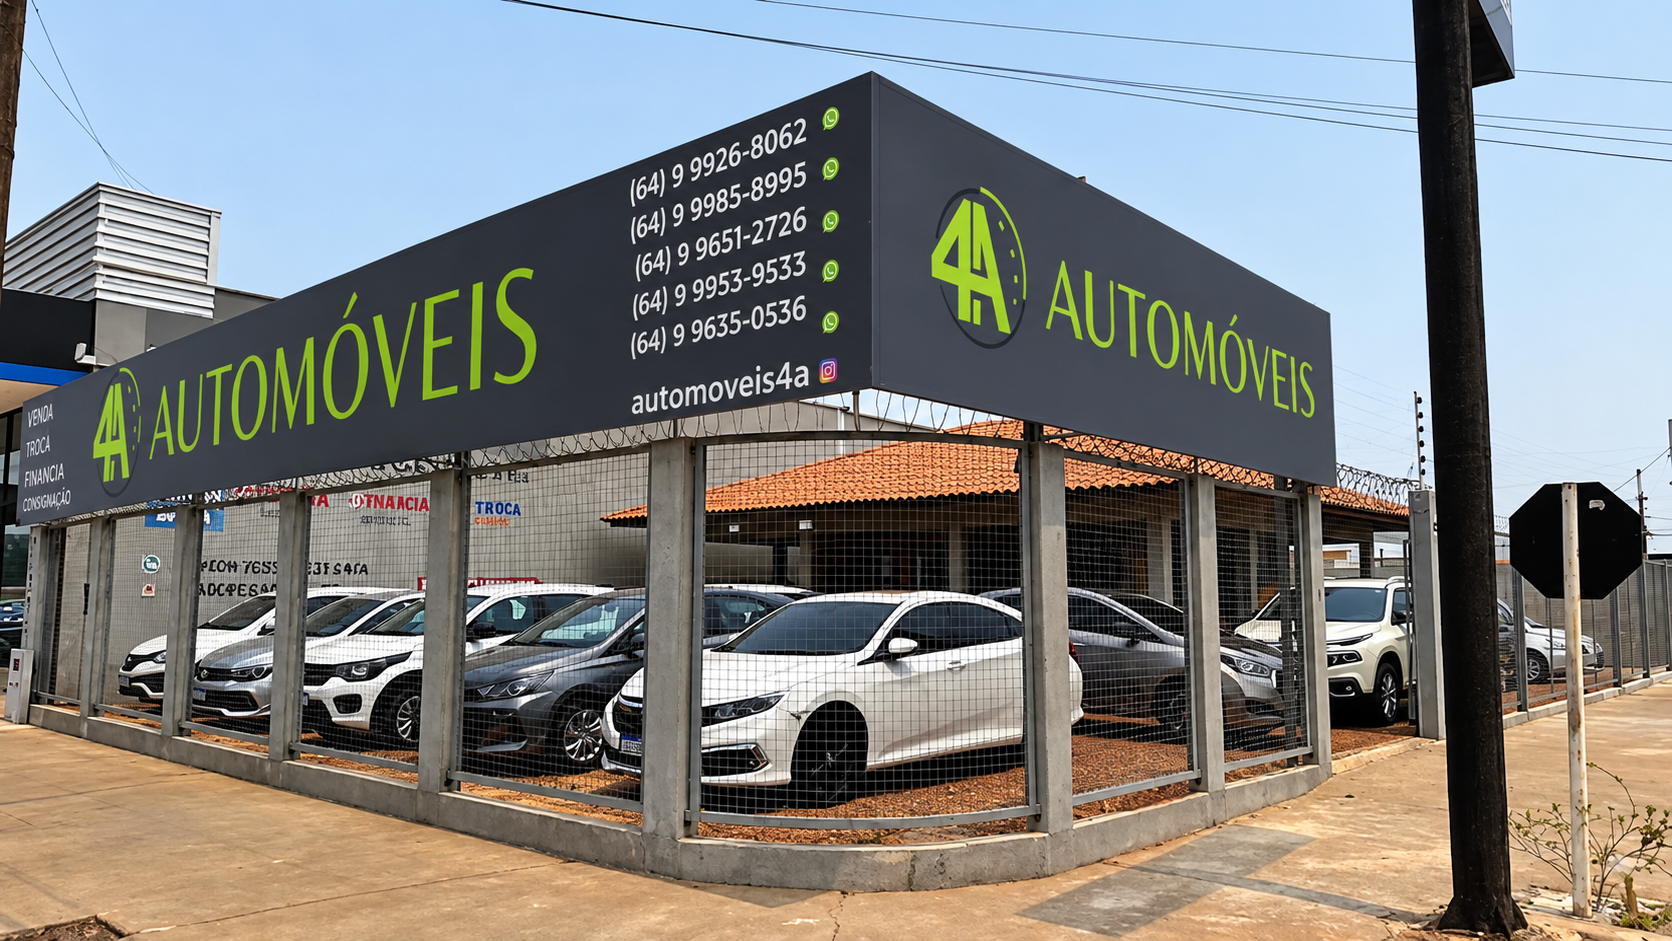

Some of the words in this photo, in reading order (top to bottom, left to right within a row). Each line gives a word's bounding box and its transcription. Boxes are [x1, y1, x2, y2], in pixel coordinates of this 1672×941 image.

[631, 168, 666, 207] (64)
[672, 164, 684, 188] 9
[690, 117, 807, 182] 9926-8062
[631, 207, 666, 244] (64)
[672, 203, 684, 228] 9
[690, 161, 807, 222] 9985-8995
[635, 246, 671, 282] (64)
[677, 243, 689, 266] 9
[695, 206, 807, 262] 9651-2726
[633, 286, 668, 321] (64)
[674, 284, 686, 307] 9
[692, 250, 807, 303] 9953-9533
[931, 198, 1012, 335] 4A
[1045, 260, 1316, 419] AUTOMÓVEIS
[631, 326, 667, 360] (64)
[673, 323, 685, 347] 9
[691, 295, 807, 343] 9635-0536
[93, 382, 130, 483] 4A
[149, 267, 538, 461] AUTOMÓVEIS
[631, 362, 810, 415] automoveis4a
[26, 435, 51, 458] TROCA
[27, 403, 54, 428] VENDA
[22, 486, 72, 512] CONSIGNAÇÃO
[24, 463, 65, 488] FINANCIA
[475, 501, 521, 516] TROCA
